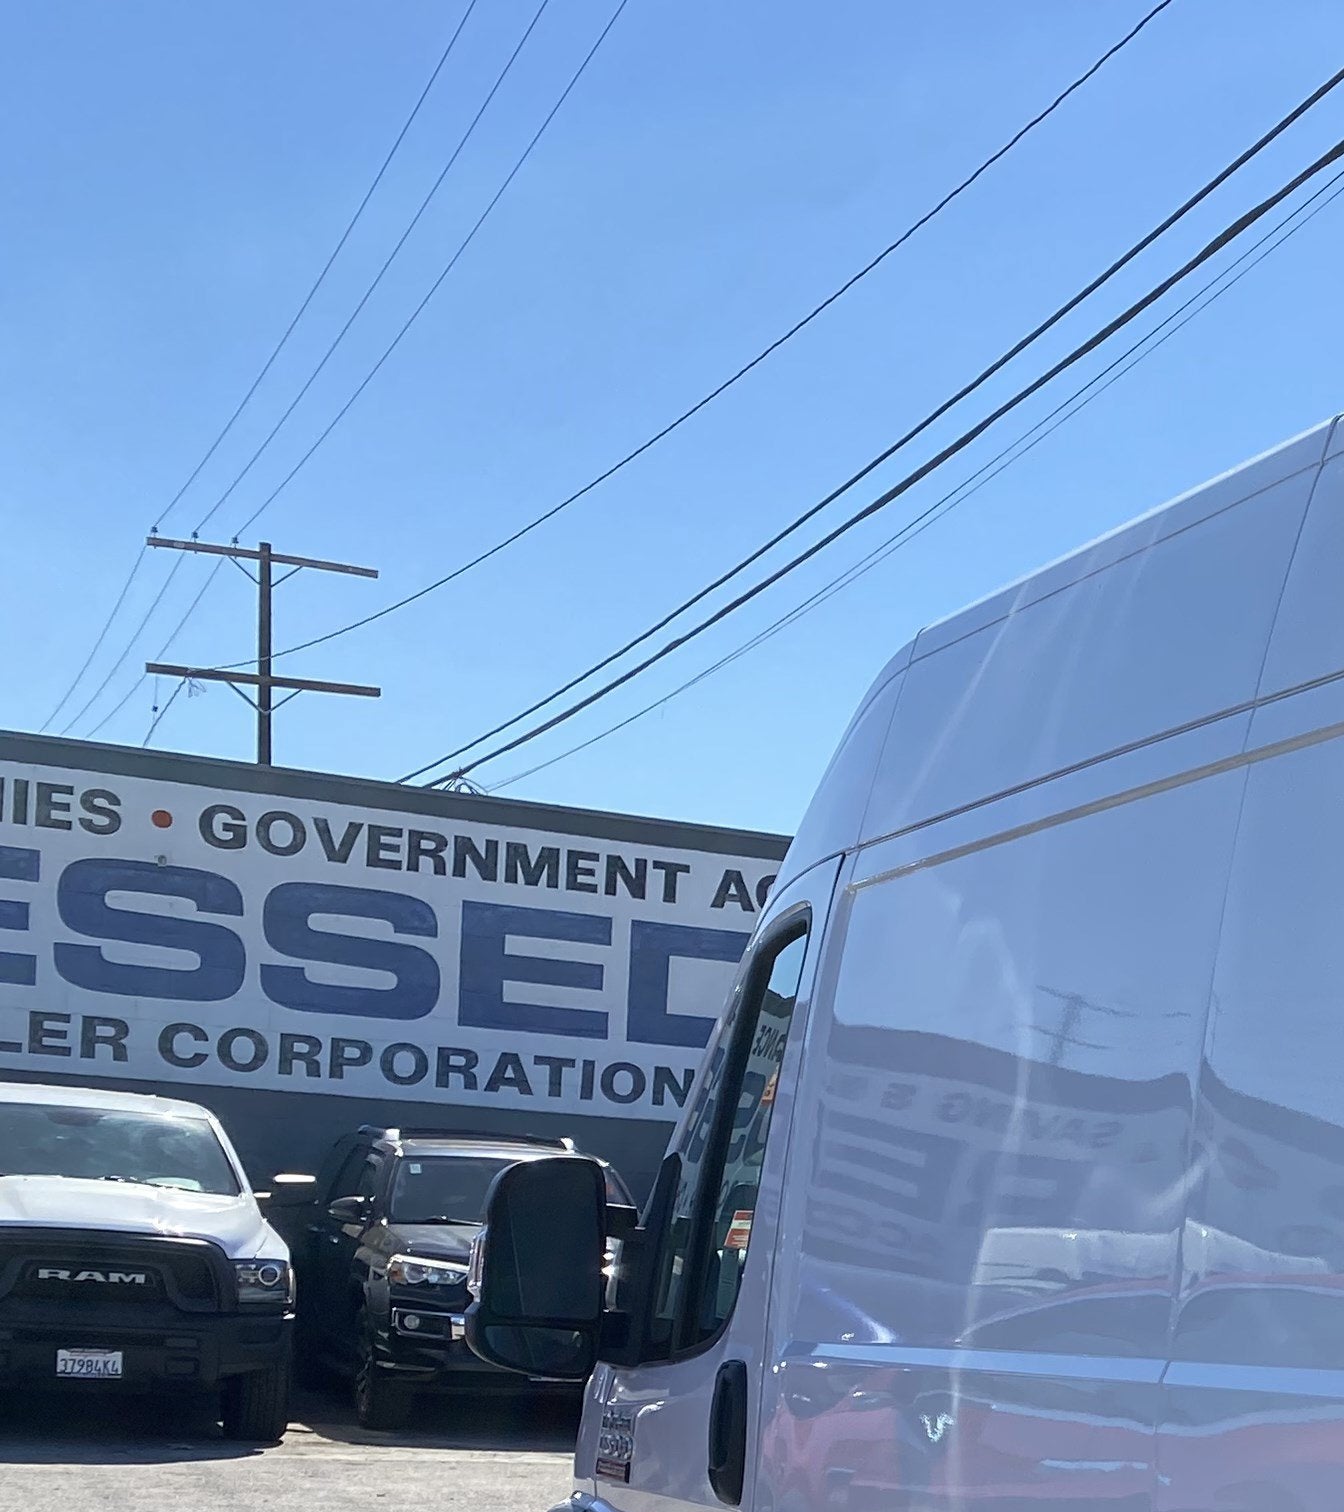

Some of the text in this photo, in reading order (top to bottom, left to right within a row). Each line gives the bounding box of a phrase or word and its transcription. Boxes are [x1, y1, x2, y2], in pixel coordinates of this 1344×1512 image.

[0, 777, 122, 835] IES
[199, 803, 691, 904] GOVERNMENT
[157, 1022, 696, 1108] CORPORATION
[38, 1268, 146, 1284] RAM
